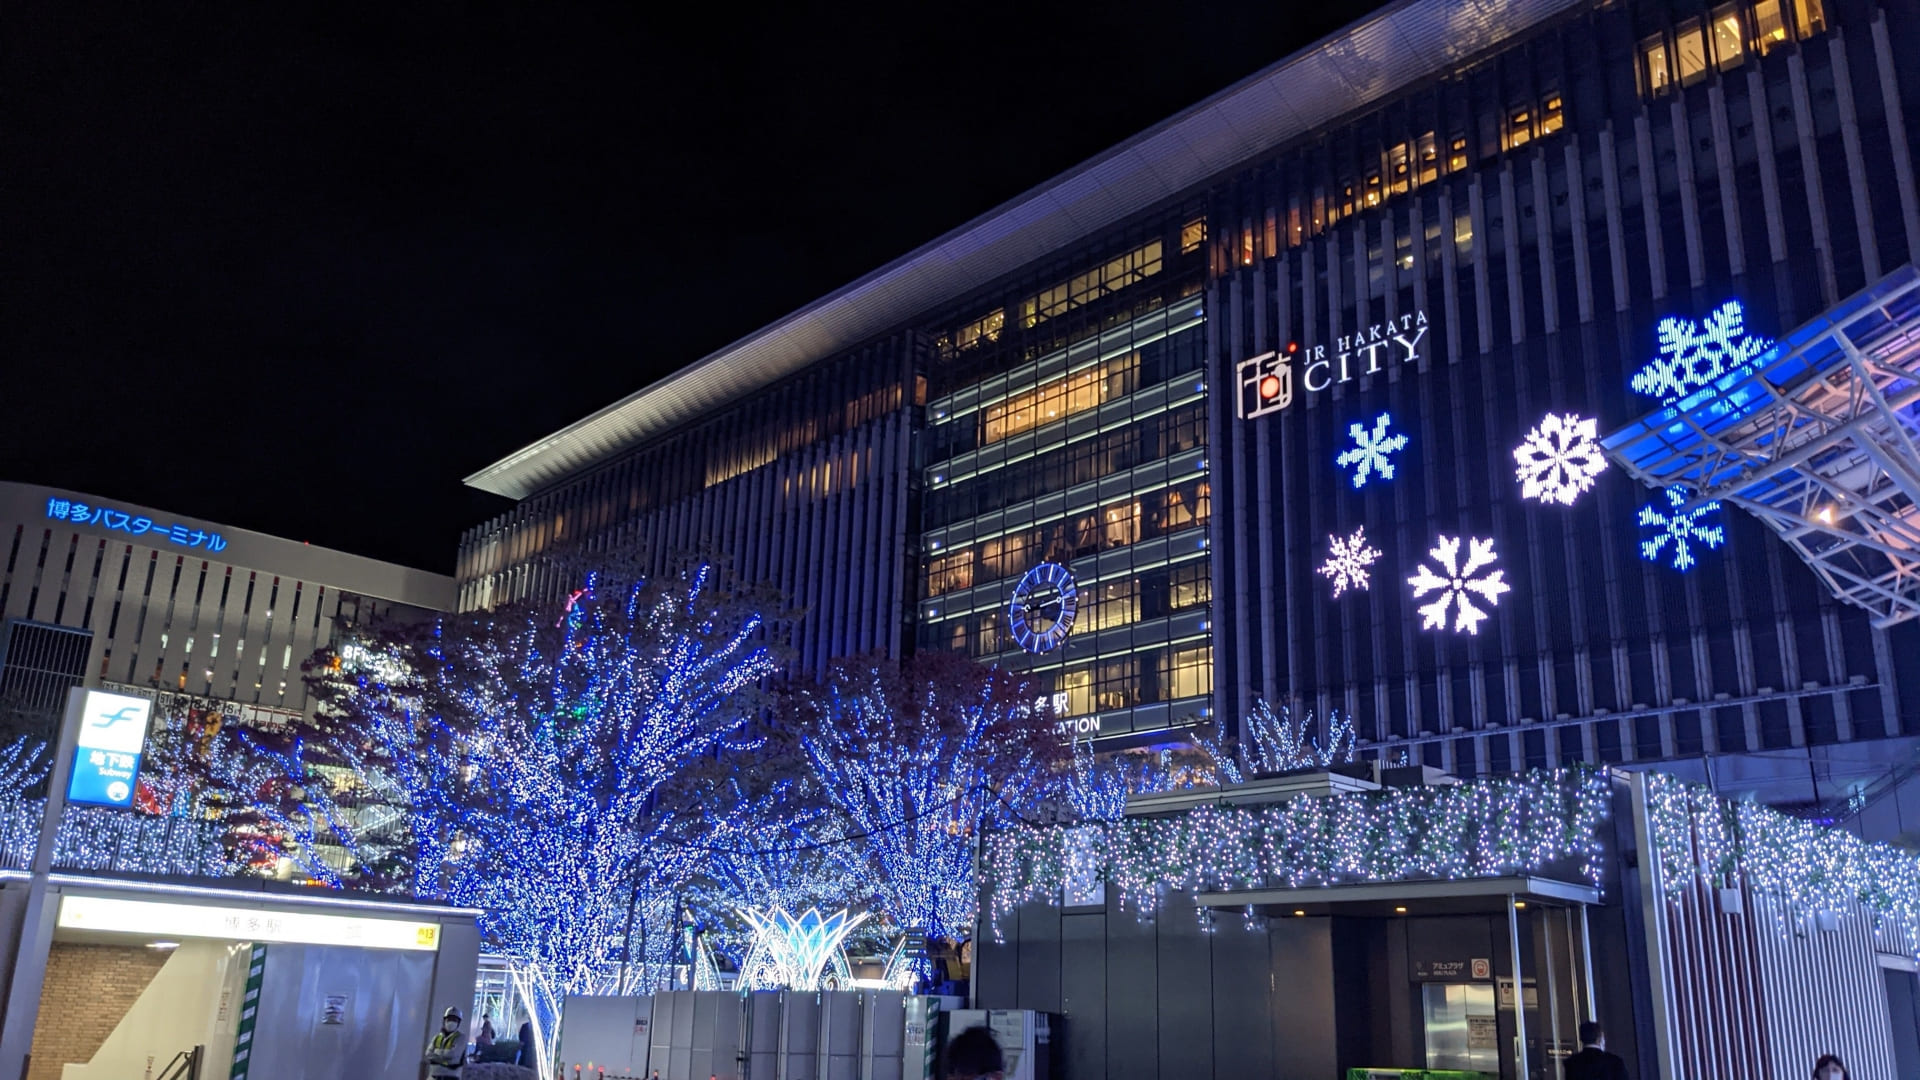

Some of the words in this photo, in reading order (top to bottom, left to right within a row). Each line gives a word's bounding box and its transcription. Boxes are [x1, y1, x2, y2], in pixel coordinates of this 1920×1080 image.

[1303, 345, 1325, 365] JR
[1338, 310, 1427, 352] HAKATA
[1304, 326, 1429, 392] CITY
[48, 498, 227, 552] 博多バスターミナル
[1052, 716, 1100, 735] ATION
[90, 751, 135, 769] 地下鉄
[99, 767, 132, 780] Subway
[225, 916, 282, 933] 博多駅
